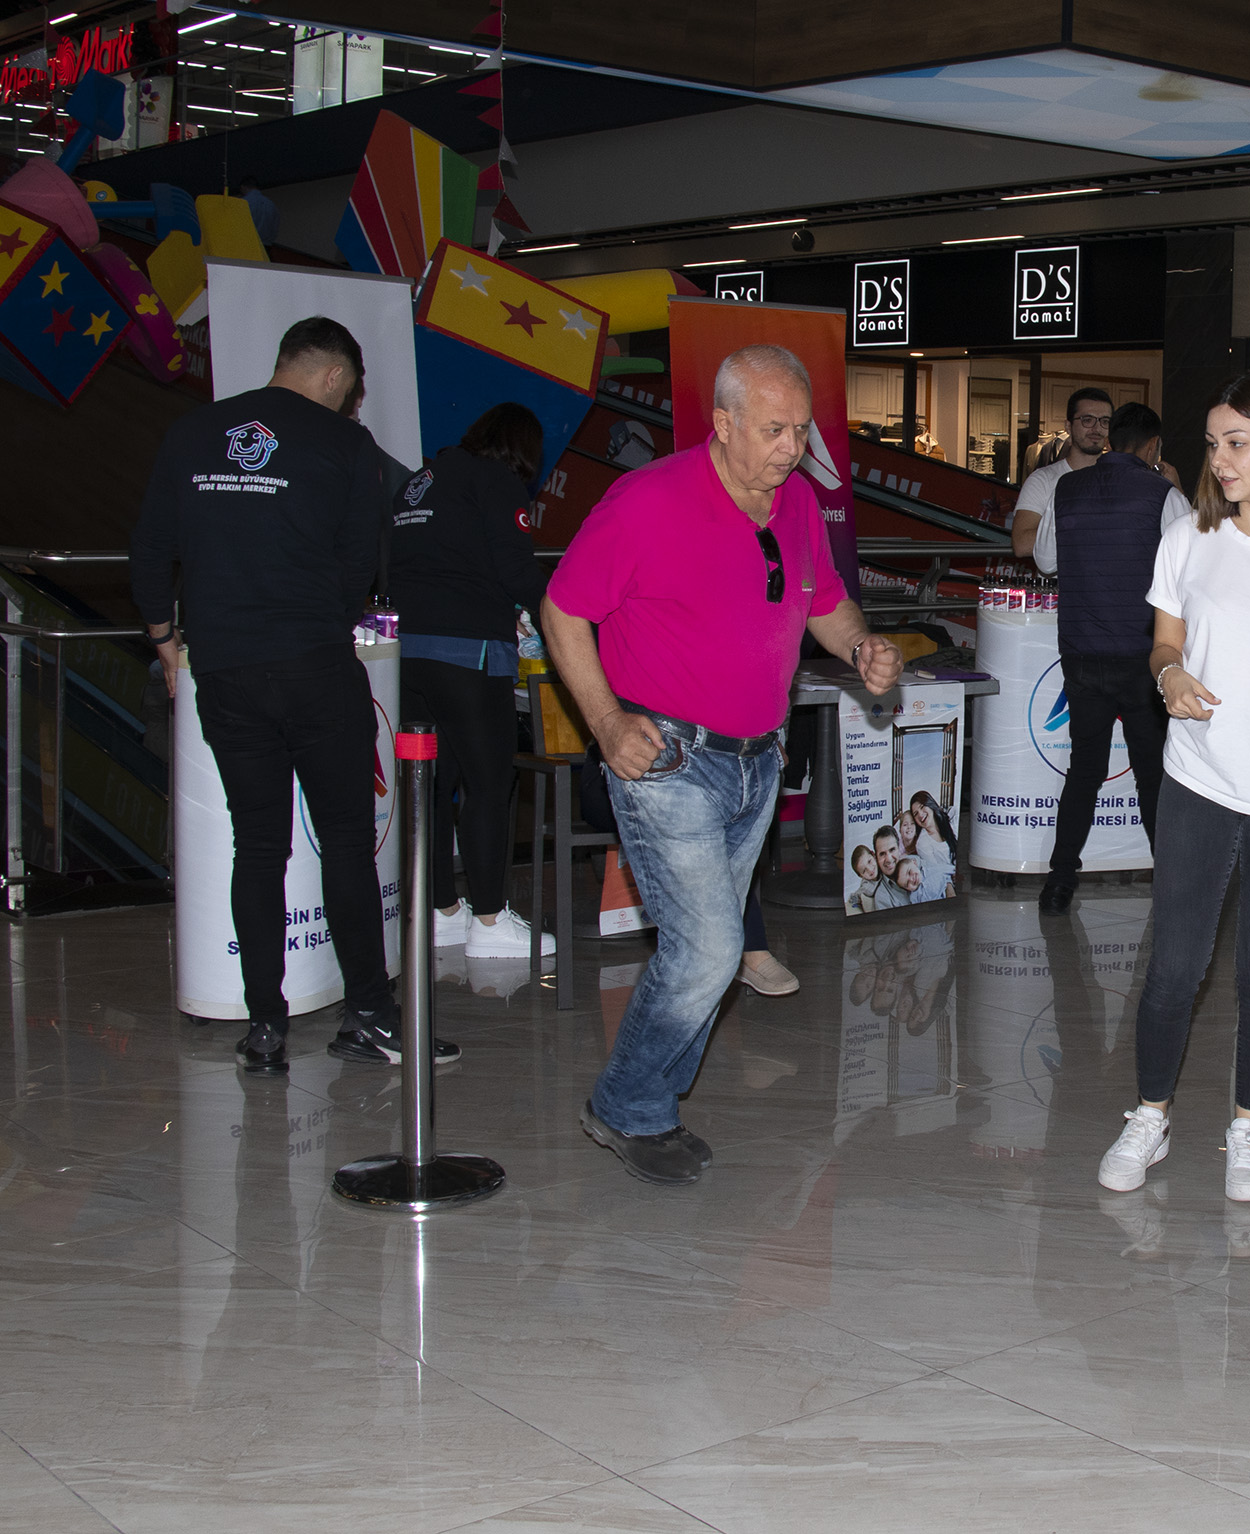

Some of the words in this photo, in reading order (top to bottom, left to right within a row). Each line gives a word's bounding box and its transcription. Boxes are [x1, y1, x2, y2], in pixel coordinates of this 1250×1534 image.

[337, 40, 371, 50] SYAPARK
[1021, 265, 1071, 302] D'S
[860, 277, 903, 312] D'S
[1020, 308, 1071, 324] damat
[859, 316, 903, 332] damat
[192, 474, 208, 483] ÖZEL
[209, 473, 239, 483] MERSİN
[239, 474, 289, 487] BÜYÜKŞEHİR
[216, 484, 242, 492] BAKIM
[242, 484, 277, 494] MERKEZİ
[845, 732, 865, 740] Uygun
[846, 741, 888, 750] Havalandırma
[847, 763, 880, 773] Havanızı
[847, 775, 870, 785] Temiz
[847, 788, 869, 798] Tutun
[848, 799, 887, 812] Sağlığınızı
[981, 794, 1030, 808] MERSİN
[848, 811, 883, 824] Koruyun!
[977, 812, 1020, 826] SAĞLIK
[1025, 814, 1056, 829] İŞLE
[1092, 813, 1126, 825] İRESİ
[305, 928, 331, 950] İŞLE
